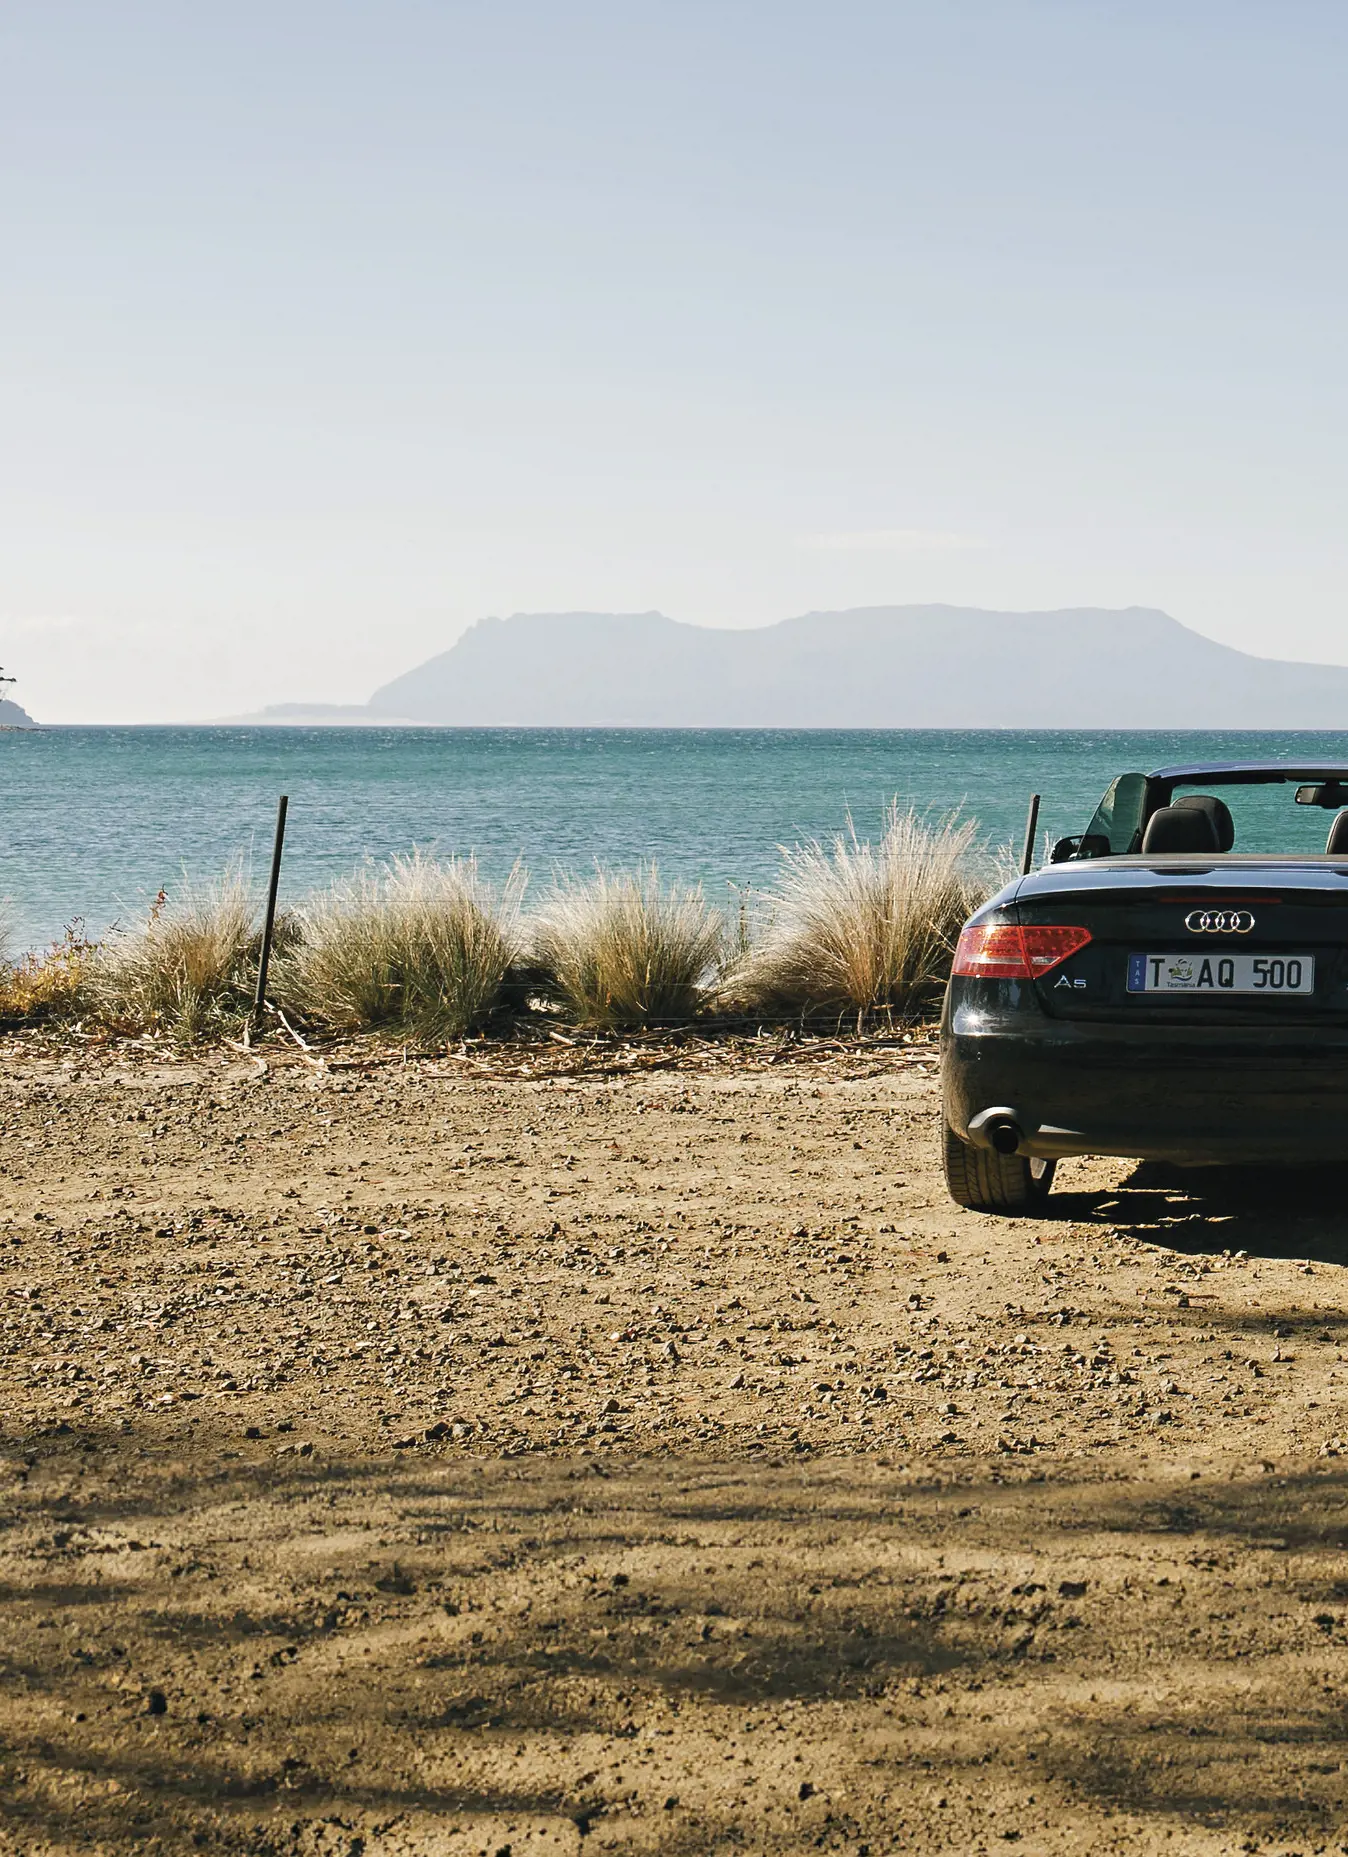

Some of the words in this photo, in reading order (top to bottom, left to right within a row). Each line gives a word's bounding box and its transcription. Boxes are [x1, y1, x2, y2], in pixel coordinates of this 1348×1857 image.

[1054, 974, 1087, 989] A5
[1196, 958, 1235, 988] AQ
[1252, 959, 1302, 989] 500
